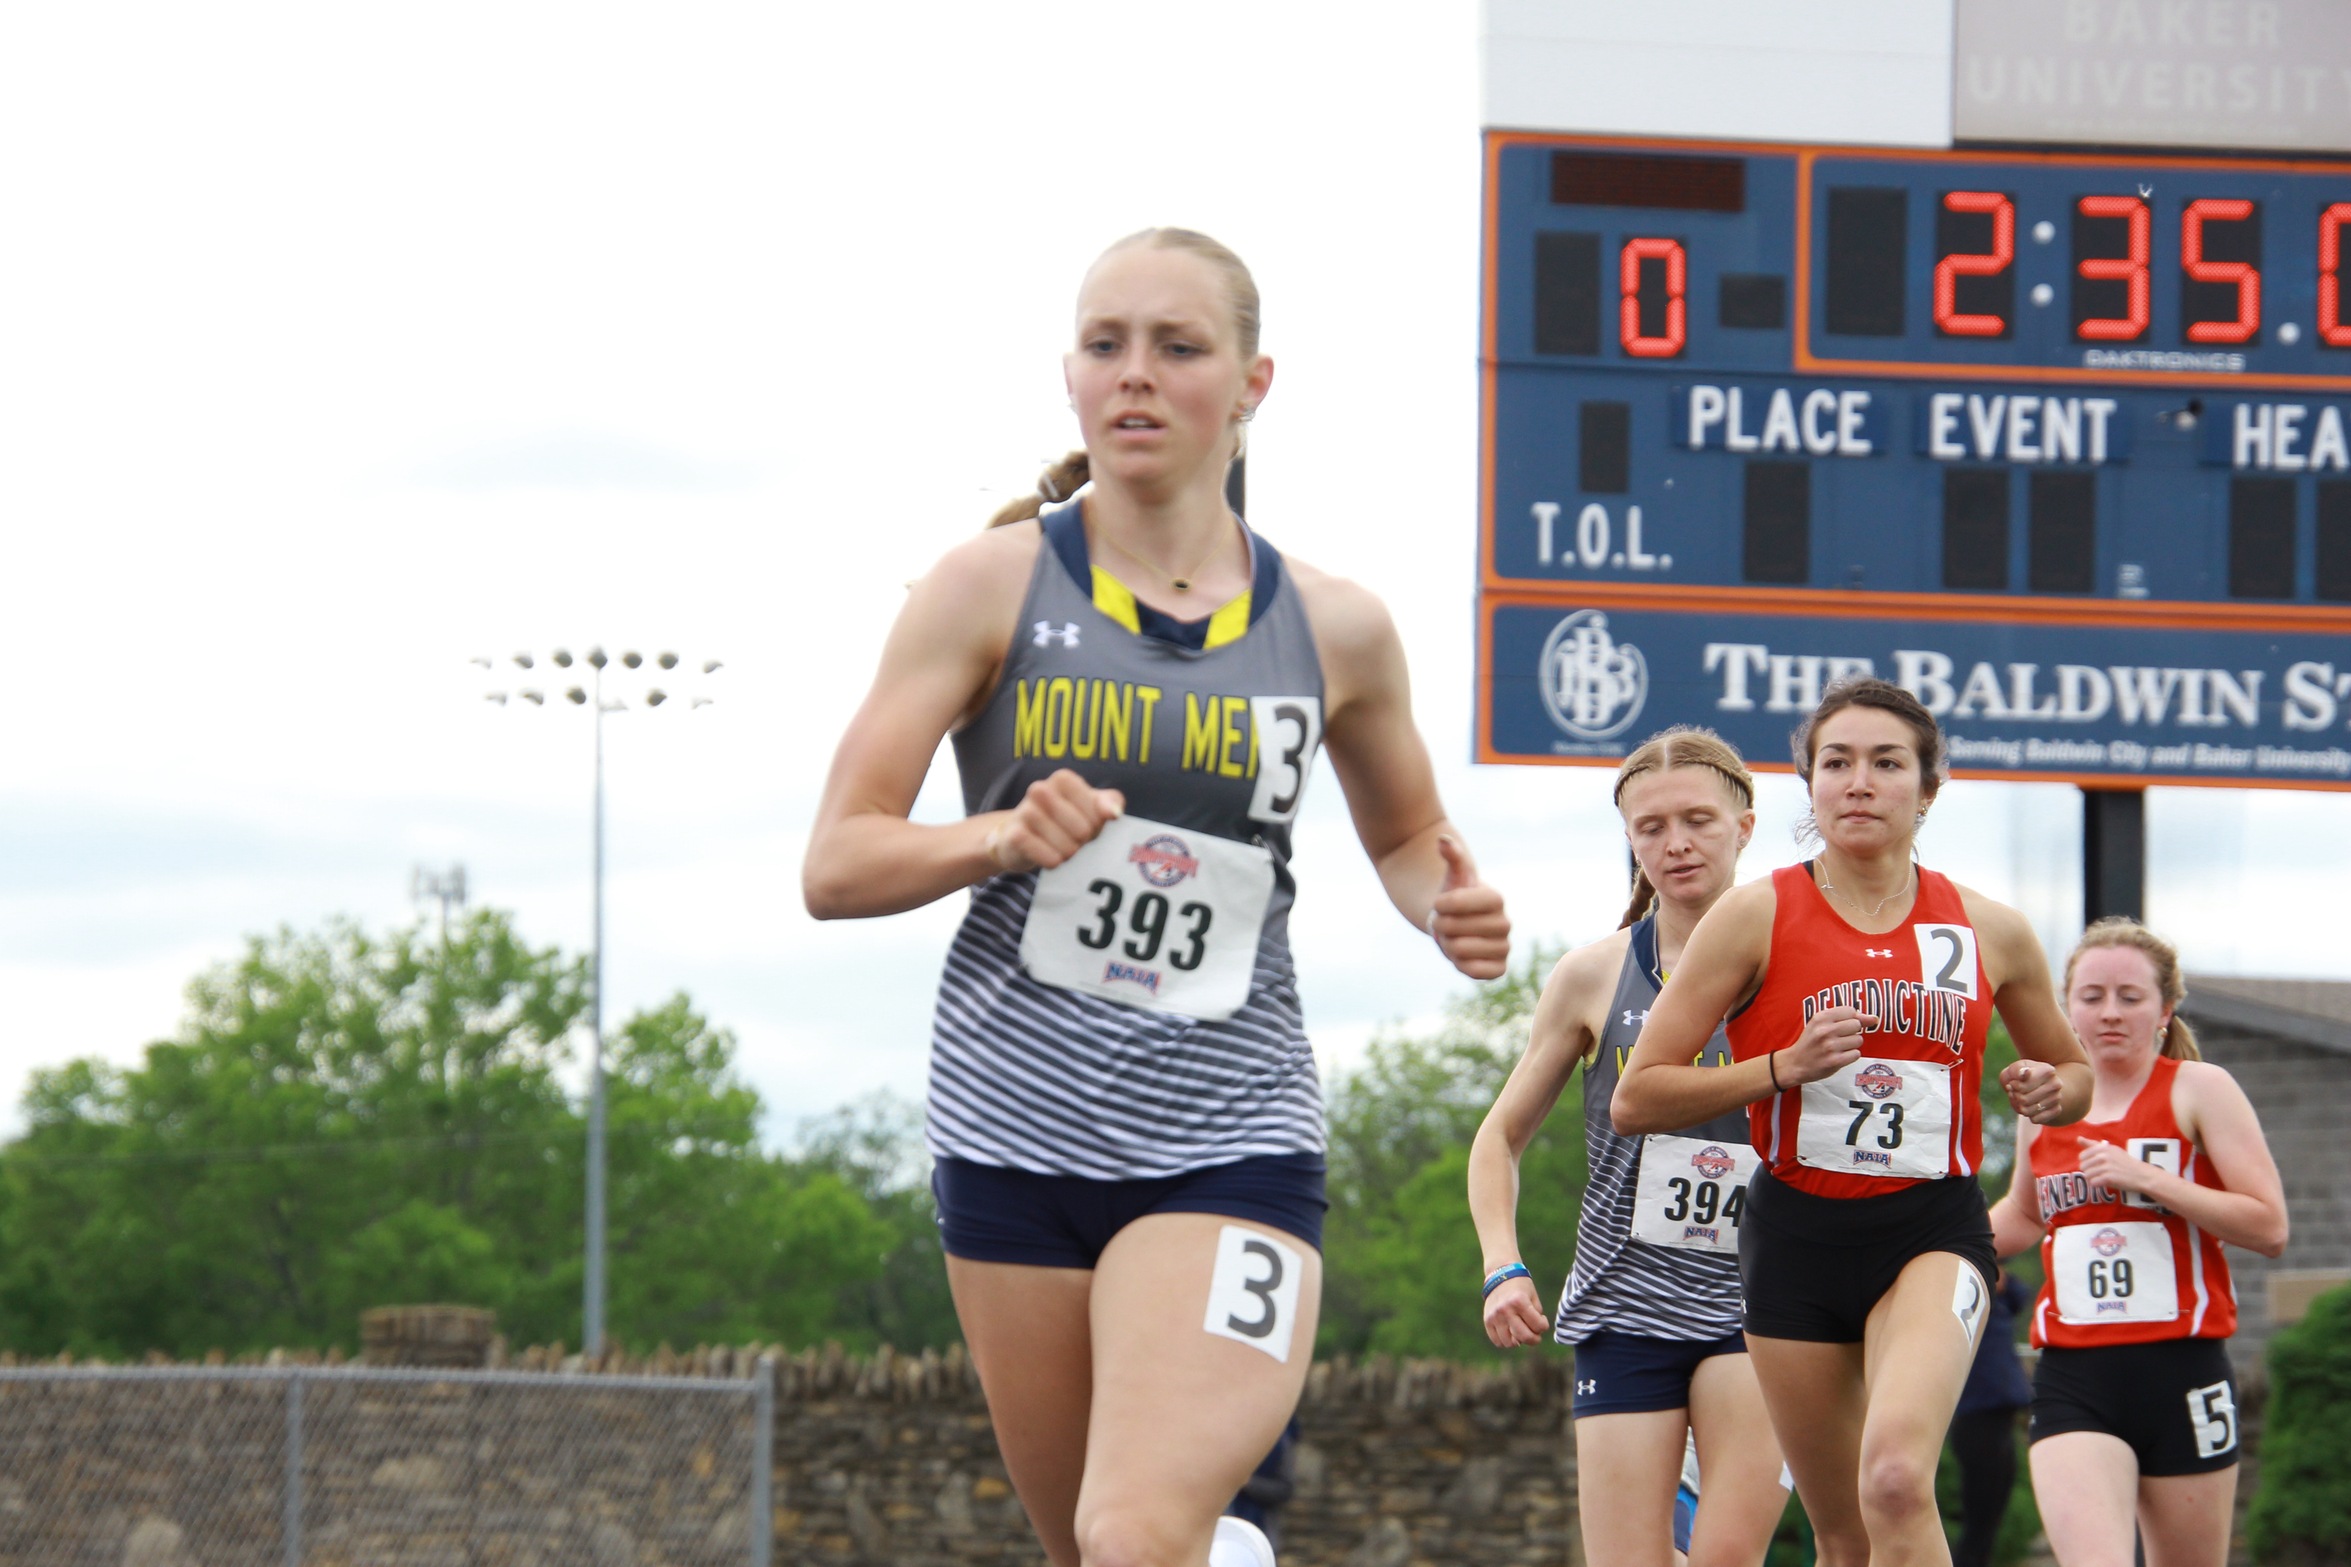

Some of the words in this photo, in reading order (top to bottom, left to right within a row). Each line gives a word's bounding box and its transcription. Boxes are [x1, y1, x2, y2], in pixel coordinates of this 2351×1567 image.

[2064, 0, 2279, 47] BAKER
[1620, 239, 1686, 357] 0
[2083, 349, 2246, 374] DAKTRONICS
[1689, 384, 1873, 455] PLACE
[1930, 393, 2117, 464] EVENT
[1531, 501, 1673, 570] T.O.L.
[1013, 676, 1162, 764] MOUNT
[1892, 649, 2266, 732] BALDWIN
[1269, 703, 1308, 814] 3
[2025, 737, 2106, 767] Baldwin
[2108, 740, 2149, 772] City
[2151, 743, 2192, 768] and
[2193, 743, 2251, 770] Baker
[1077, 877, 1214, 970] 393
[1103, 962, 1161, 994] NAIA
[1930, 928, 1968, 993] 2
[1845, 1100, 1904, 1149] 73
[1853, 1150, 1891, 1168] NAIA
[1664, 1177, 1746, 1227] 394
[1684, 1226, 1718, 1244] NAIA
[1227, 1239, 1283, 1338] 3
[2088, 1258, 2134, 1298] 69
[2202, 1388, 2230, 1451] 5
